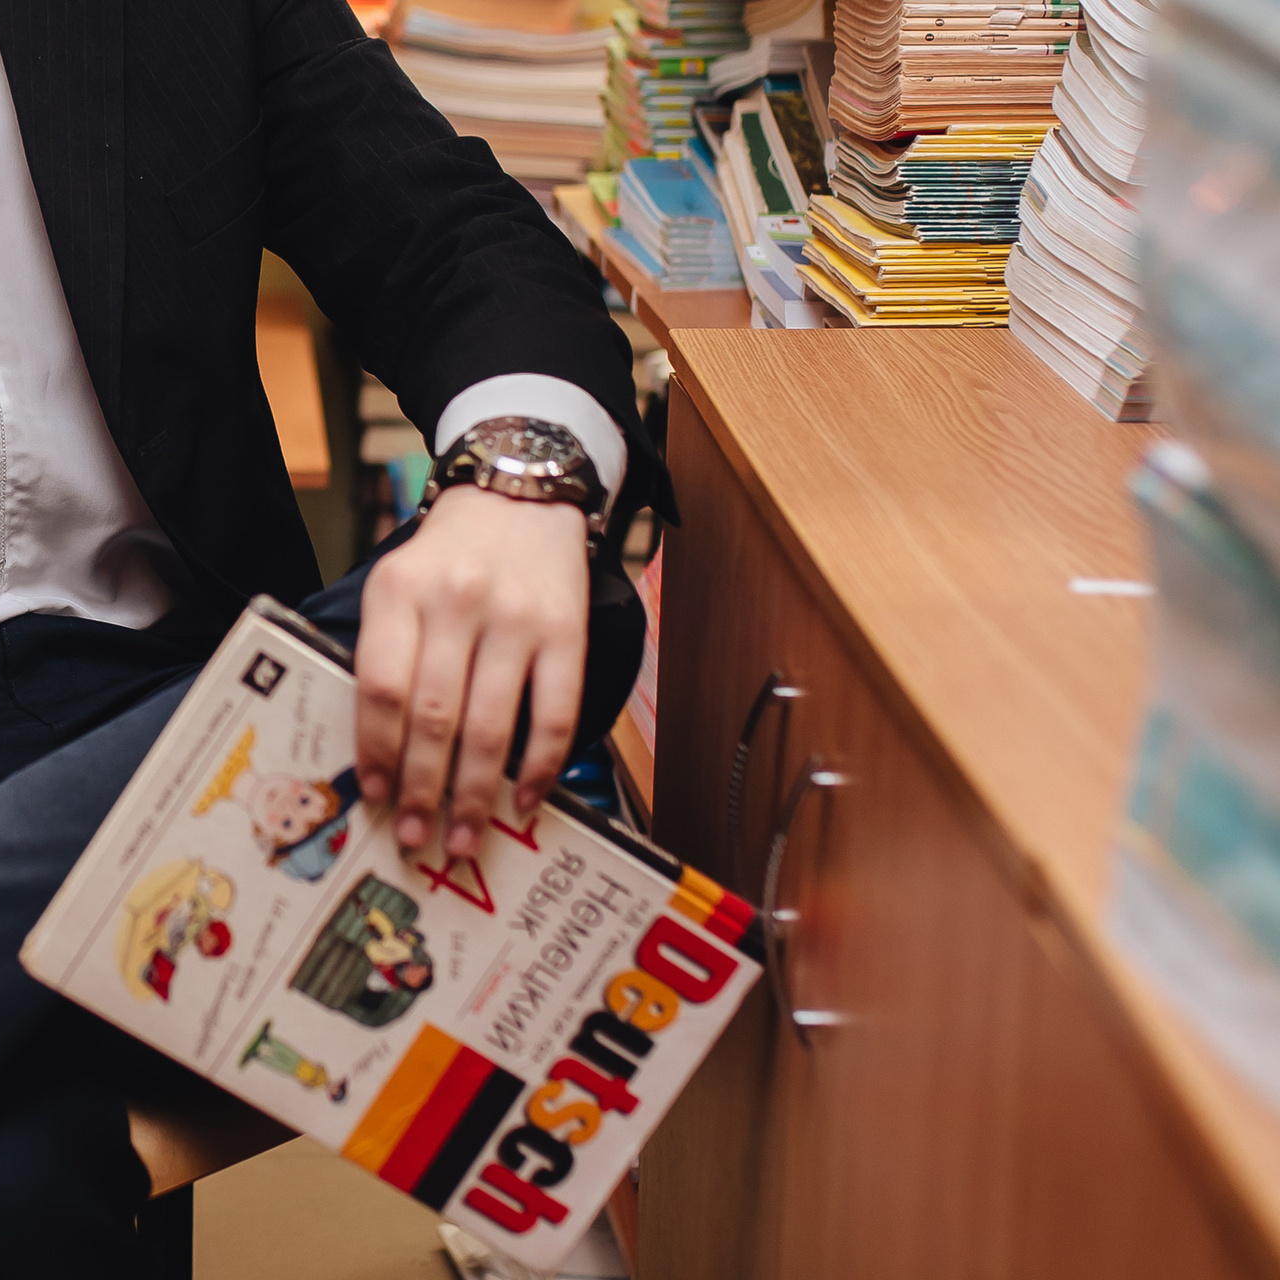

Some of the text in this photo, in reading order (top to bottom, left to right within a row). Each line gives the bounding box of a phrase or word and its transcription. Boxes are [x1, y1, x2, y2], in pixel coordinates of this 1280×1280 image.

[487, 874, 632, 1052] Немецкий
[509, 846, 586, 938] язык
[461, 914, 739, 1234] Deutsch
